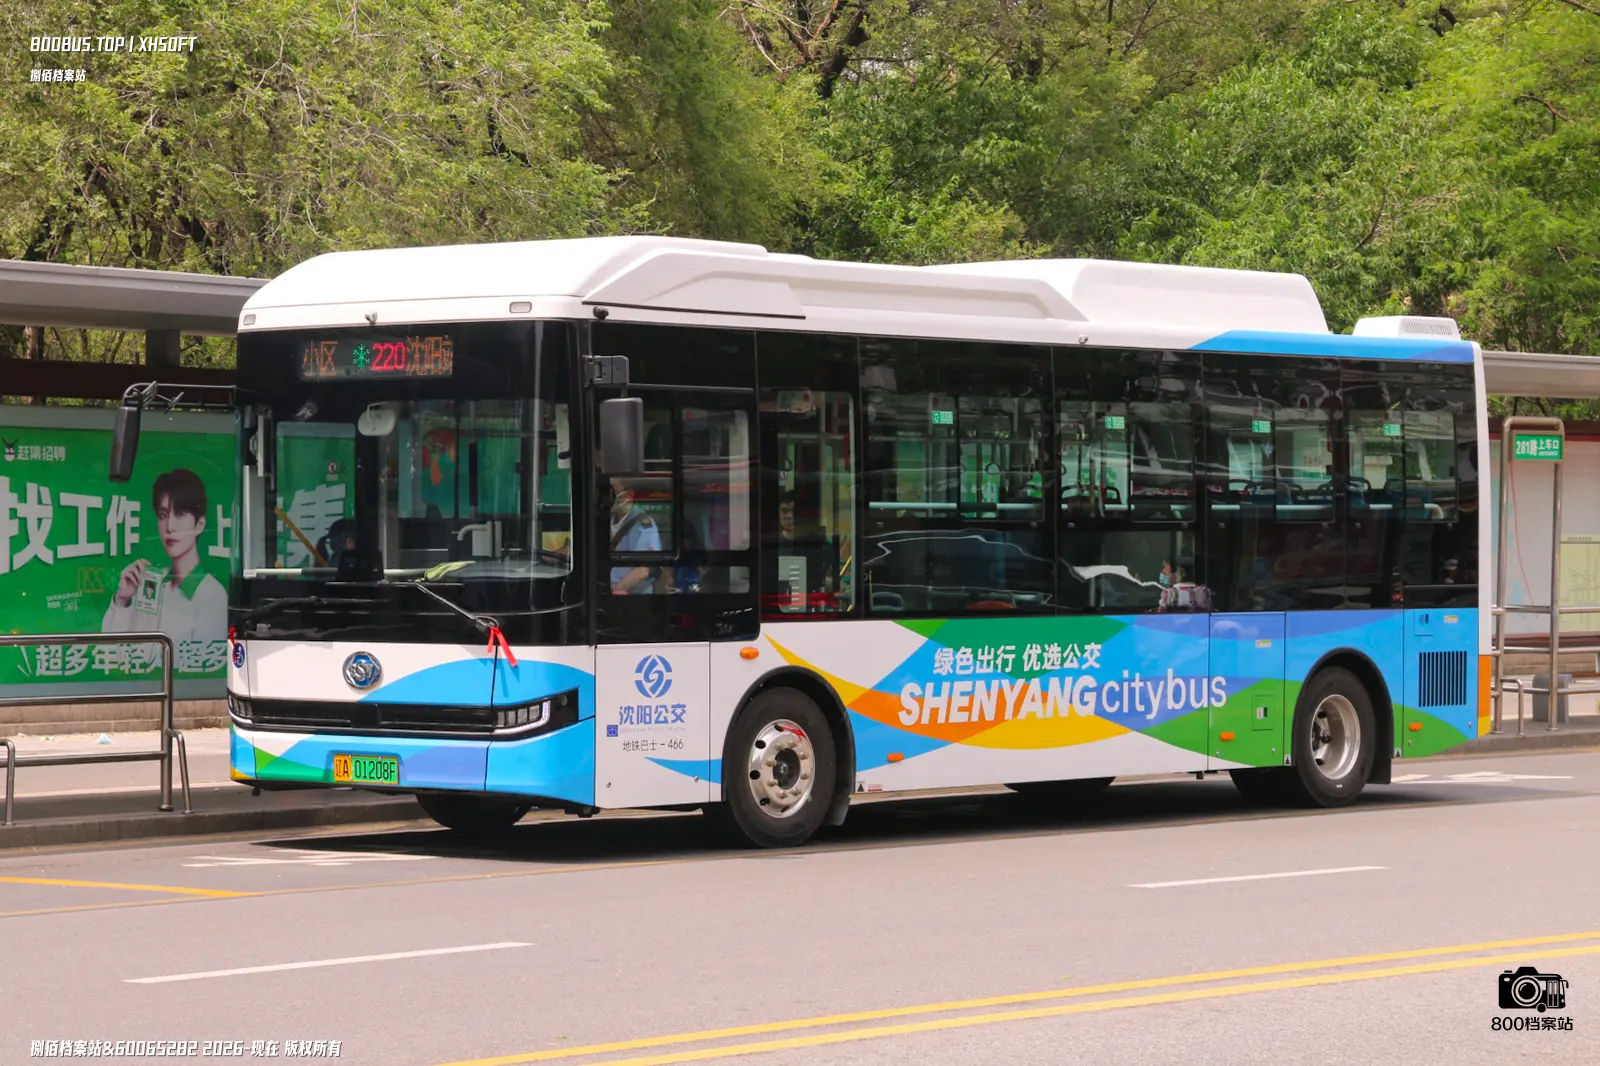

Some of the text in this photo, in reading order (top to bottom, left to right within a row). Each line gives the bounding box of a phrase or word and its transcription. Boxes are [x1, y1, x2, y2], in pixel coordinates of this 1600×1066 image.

[371, 342, 407, 371] 220
[17, 444, 66, 462] 赶集招聘
[0, 474, 142, 574] 找工作
[933, 642, 1102, 676] 绿色出行 优选公交
[898, 668, 1228, 726] SHENYANG citybus
[618, 703, 687, 726] 沈阳公交
